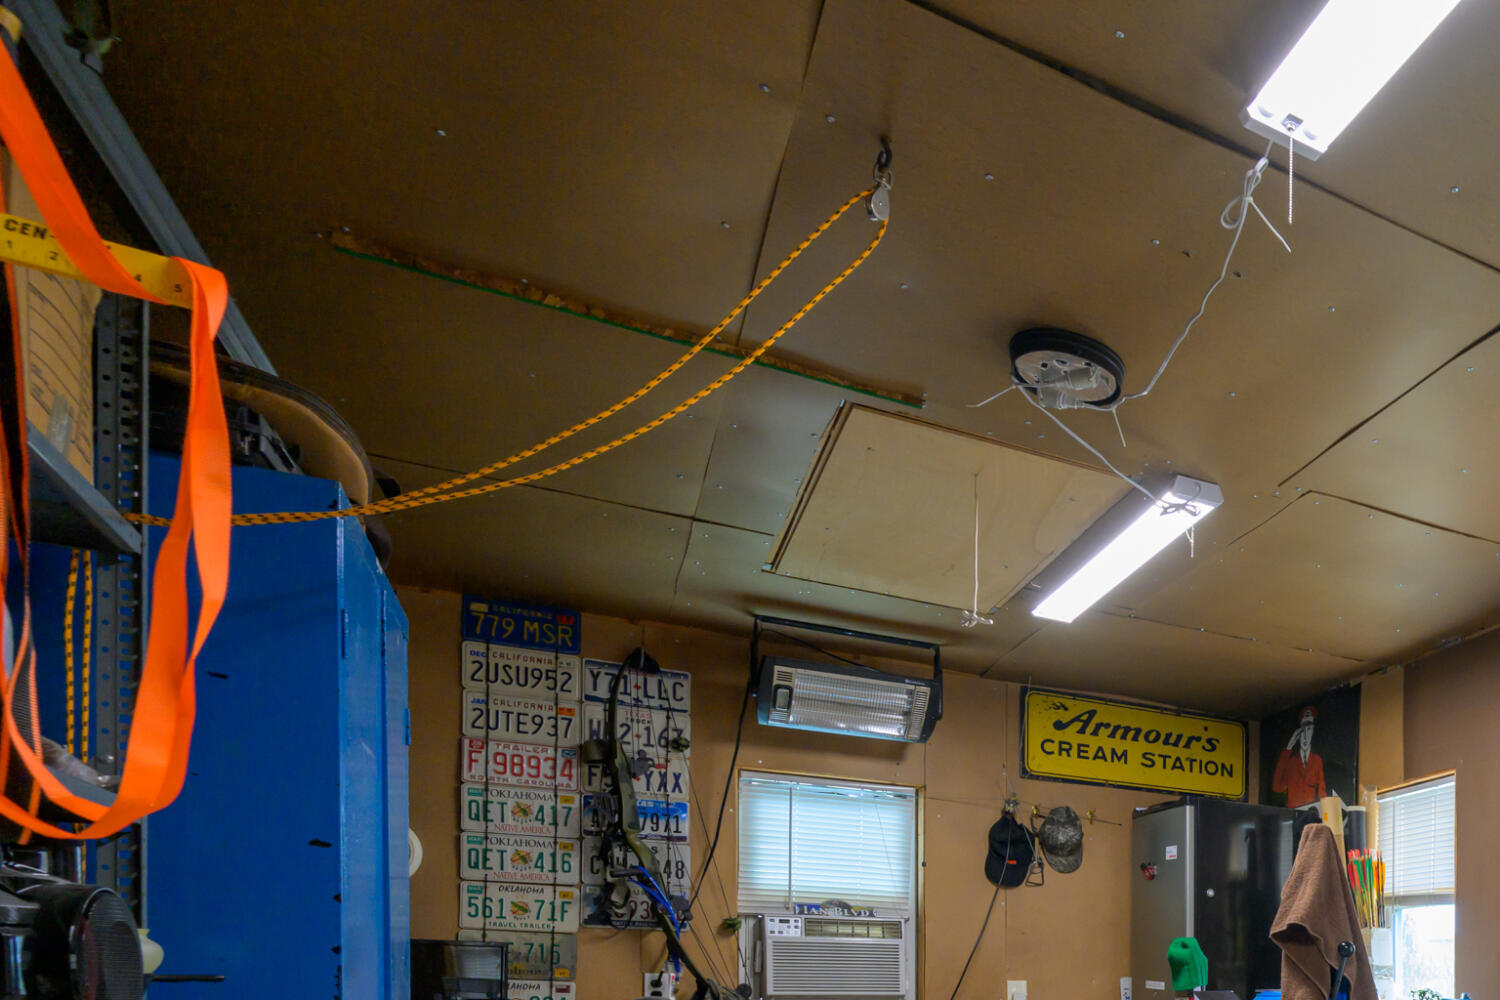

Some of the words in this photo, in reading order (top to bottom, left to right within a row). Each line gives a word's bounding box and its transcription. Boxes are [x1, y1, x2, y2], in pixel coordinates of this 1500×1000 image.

[471, 612, 515, 638] 779
[523, 620, 573, 647] MSR
[492, 651, 553, 665] CALIFORNIA
[471, 660, 572, 693] 2USU952
[493, 698, 554, 712] CALIFORNIA
[471, 708, 573, 739] 2UTE937
[1053, 708, 1220, 753] Armour's
[495, 743, 549, 754] TRAILER
[1041, 739, 1128, 765] CREAM
[1141, 752, 1234, 778] STATION
[490, 788, 553, 802] OKLAHOMA
[468, 799, 507, 823] QET
[535, 804, 572, 827] 417
[489, 836, 553, 849] OKLAHOMA
[468, 847, 507, 871] QET
[534, 851, 572, 873] 416
[498, 884, 545, 895] OKLAHOMA
[467, 896, 507, 919] 561
[534, 900, 572, 922] 71F
[833, 906, 870, 917] BLVD
